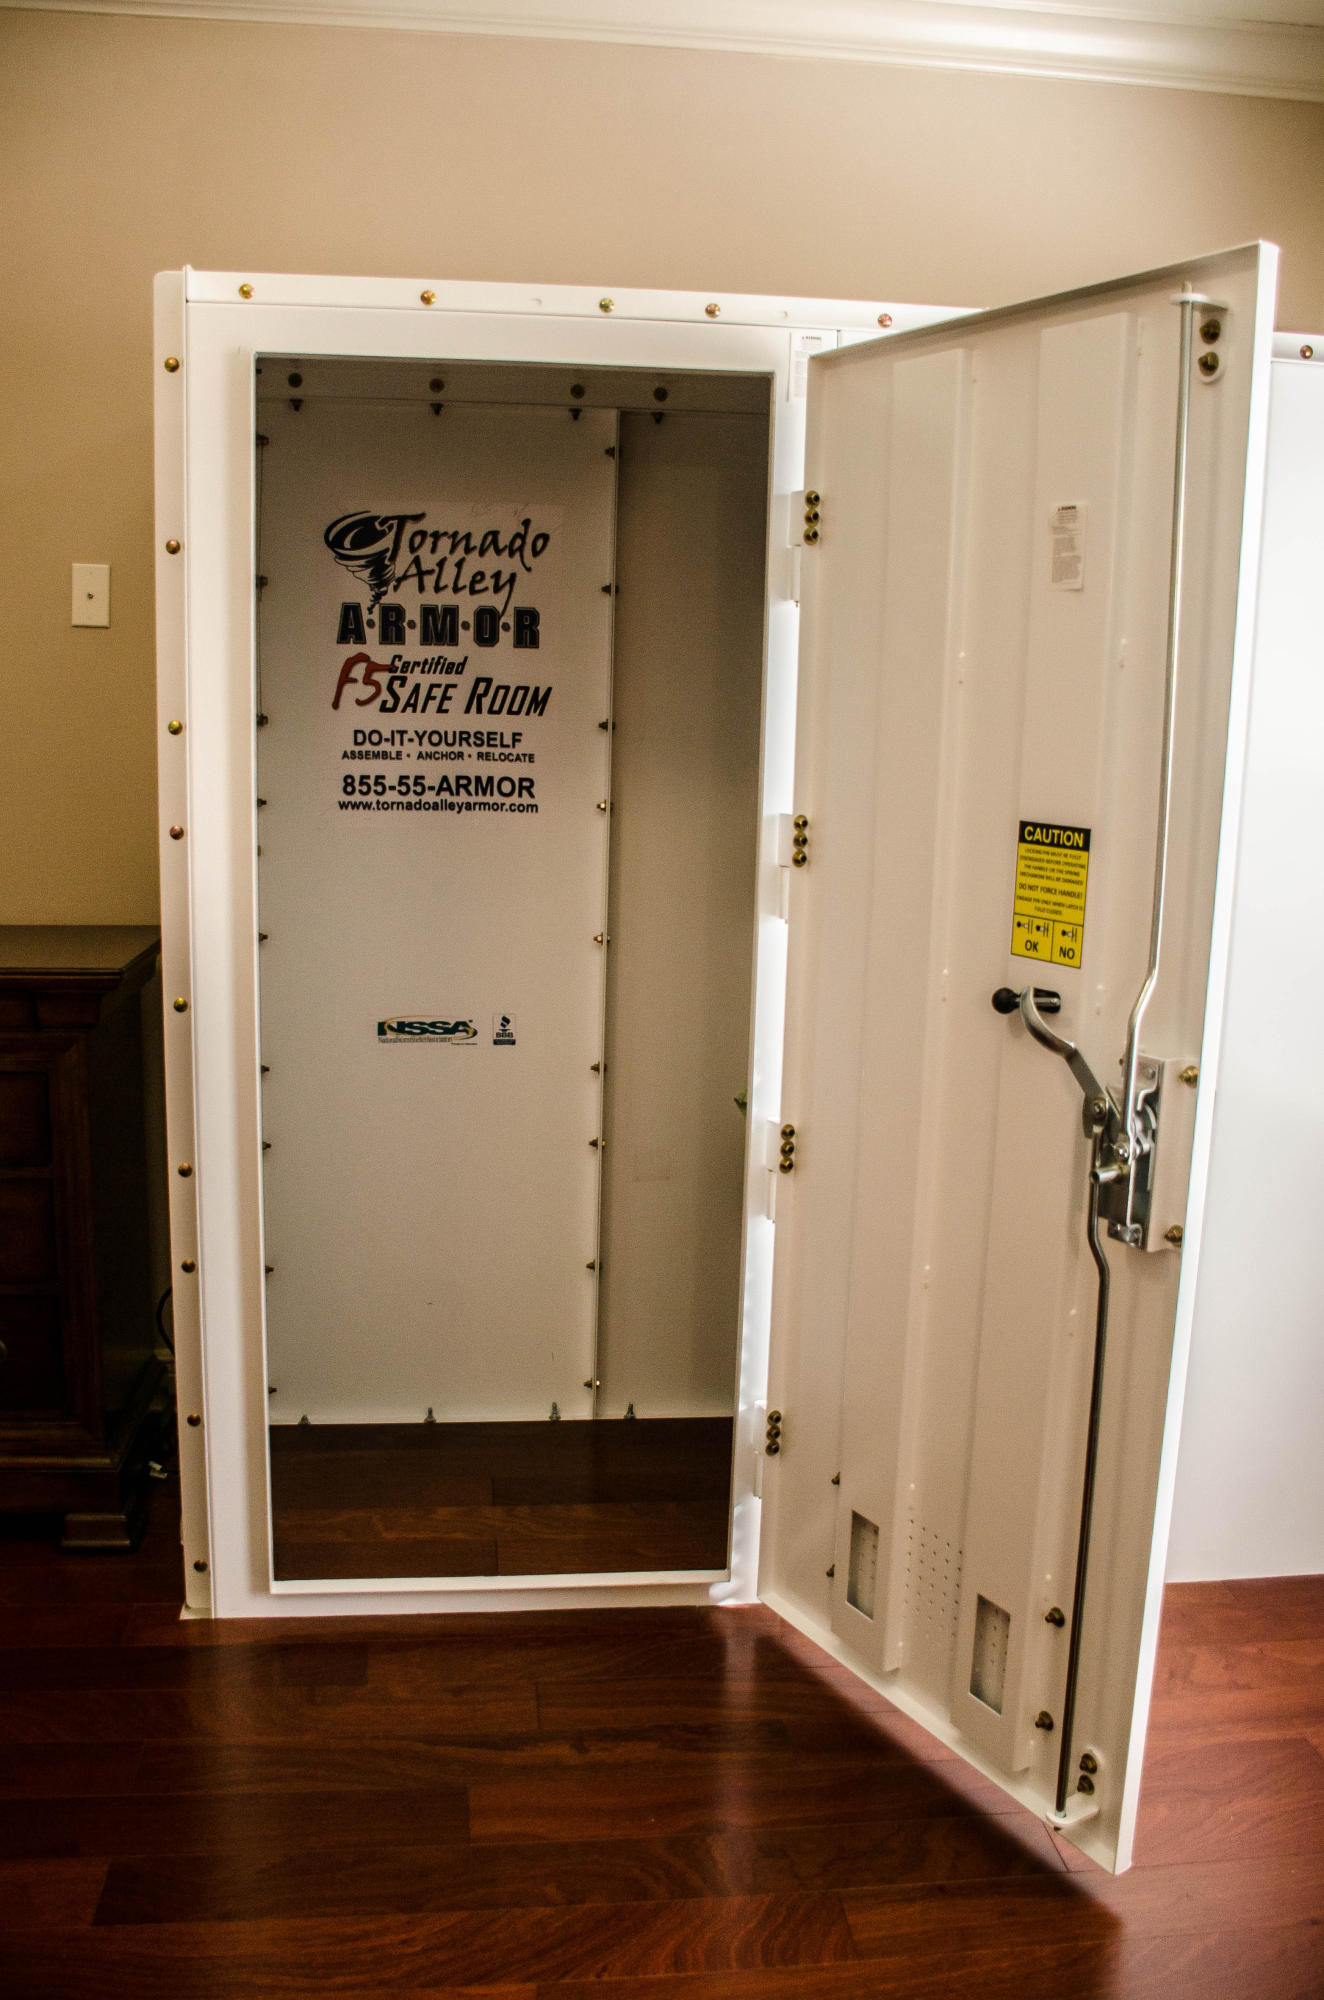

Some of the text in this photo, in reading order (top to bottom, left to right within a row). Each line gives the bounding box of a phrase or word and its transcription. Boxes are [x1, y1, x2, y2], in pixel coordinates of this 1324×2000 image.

[376, 511, 550, 572] Tornado
[394, 555, 517, 620] Alley
[332, 652, 468, 710] F5 Certified
[379, 676, 552, 716] SAFE ROOM
[353, 729, 523, 748] DO-IT-YOURSELF
[341, 750, 535, 763] ASSEMBLE ANCHOR RELOCATE
[342, 774, 535, 798] 855-55-ARMOR
[338, 799, 539, 814] www.tornadoalleyarmor.com
[1024, 826, 1084, 848] CAUTION
[1040, 887, 1057, 895] FORCE
[1025, 940, 1039, 952] OK
[1059, 947, 1075, 960] NO
[378, 1020, 478, 1036] NSSA
